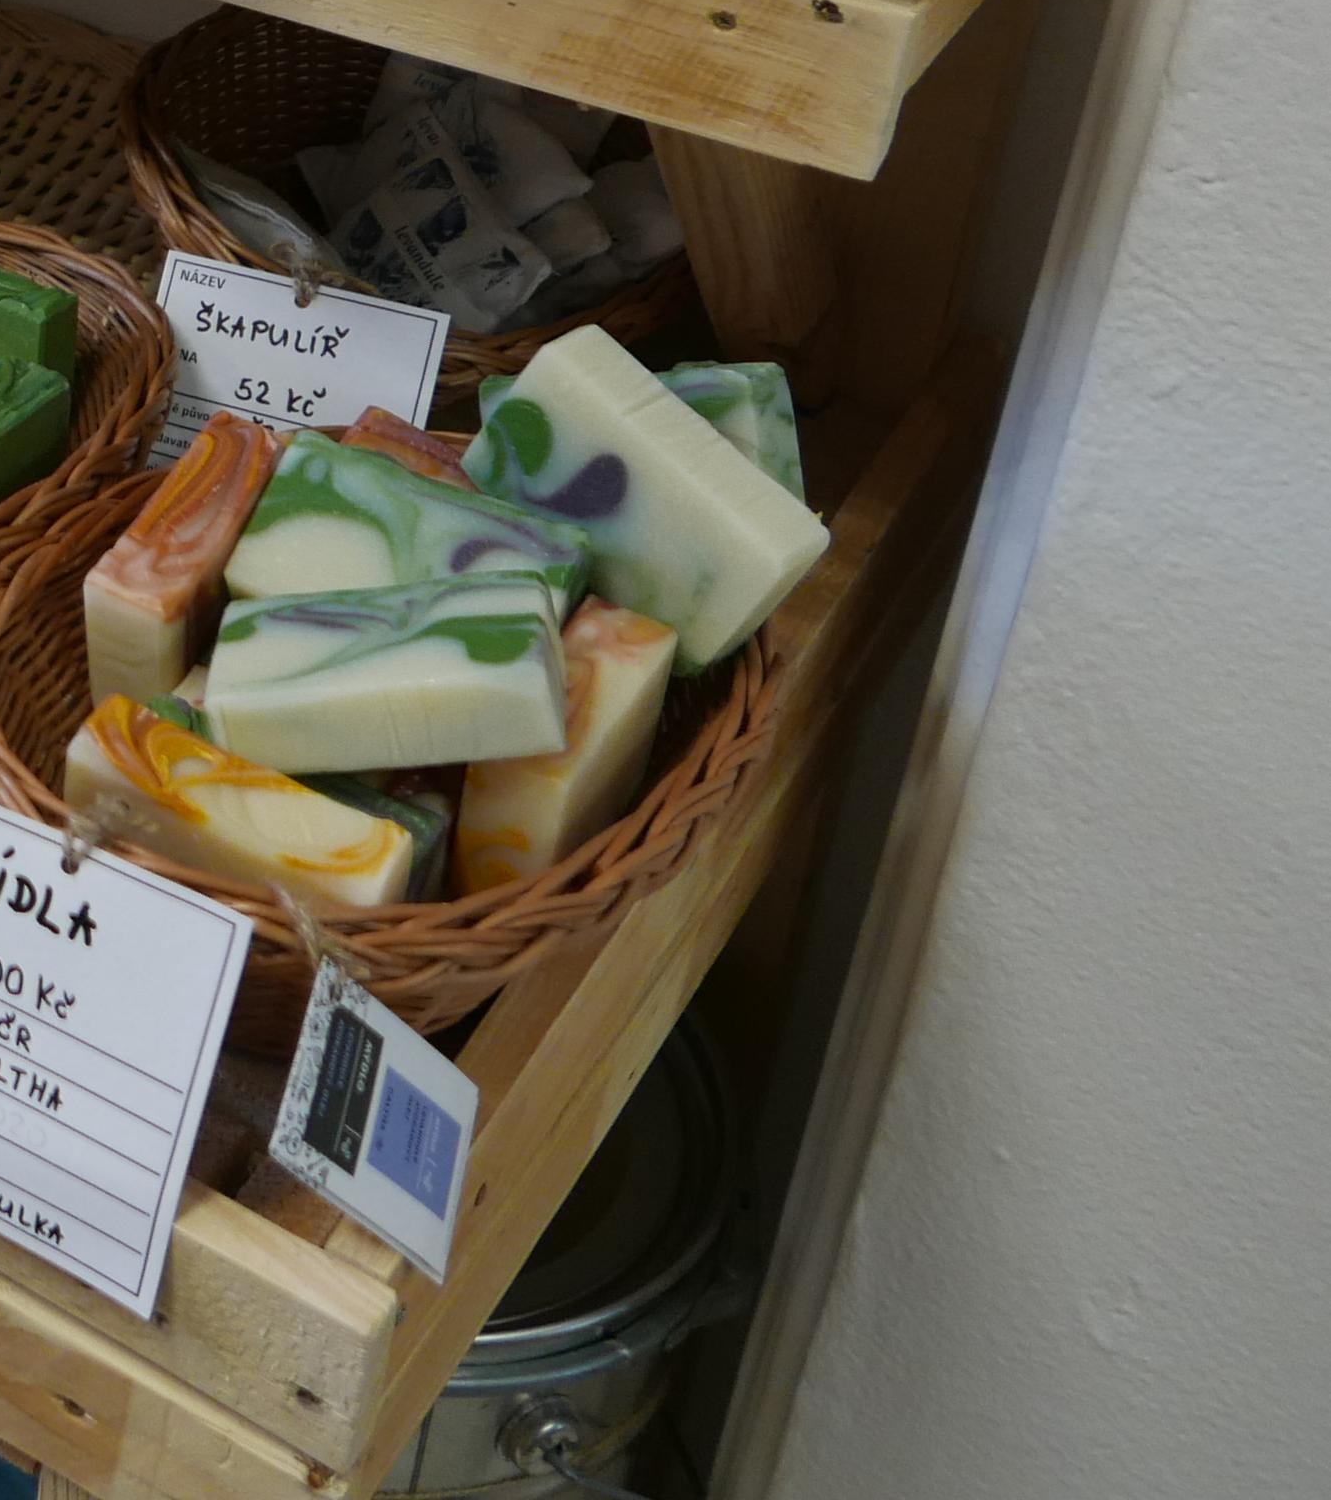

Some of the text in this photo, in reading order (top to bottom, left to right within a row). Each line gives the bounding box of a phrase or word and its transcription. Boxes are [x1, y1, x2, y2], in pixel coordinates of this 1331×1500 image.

[180, 268, 226, 290] NÁZEV
[393, 224, 446, 292] levandule
[196, 300, 350, 359] ŠKAPULÍŘ
[179, 347, 198, 365] NA
[234, 377, 327, 418] 52 Kč
[36, 973, 76, 1020] Kč
